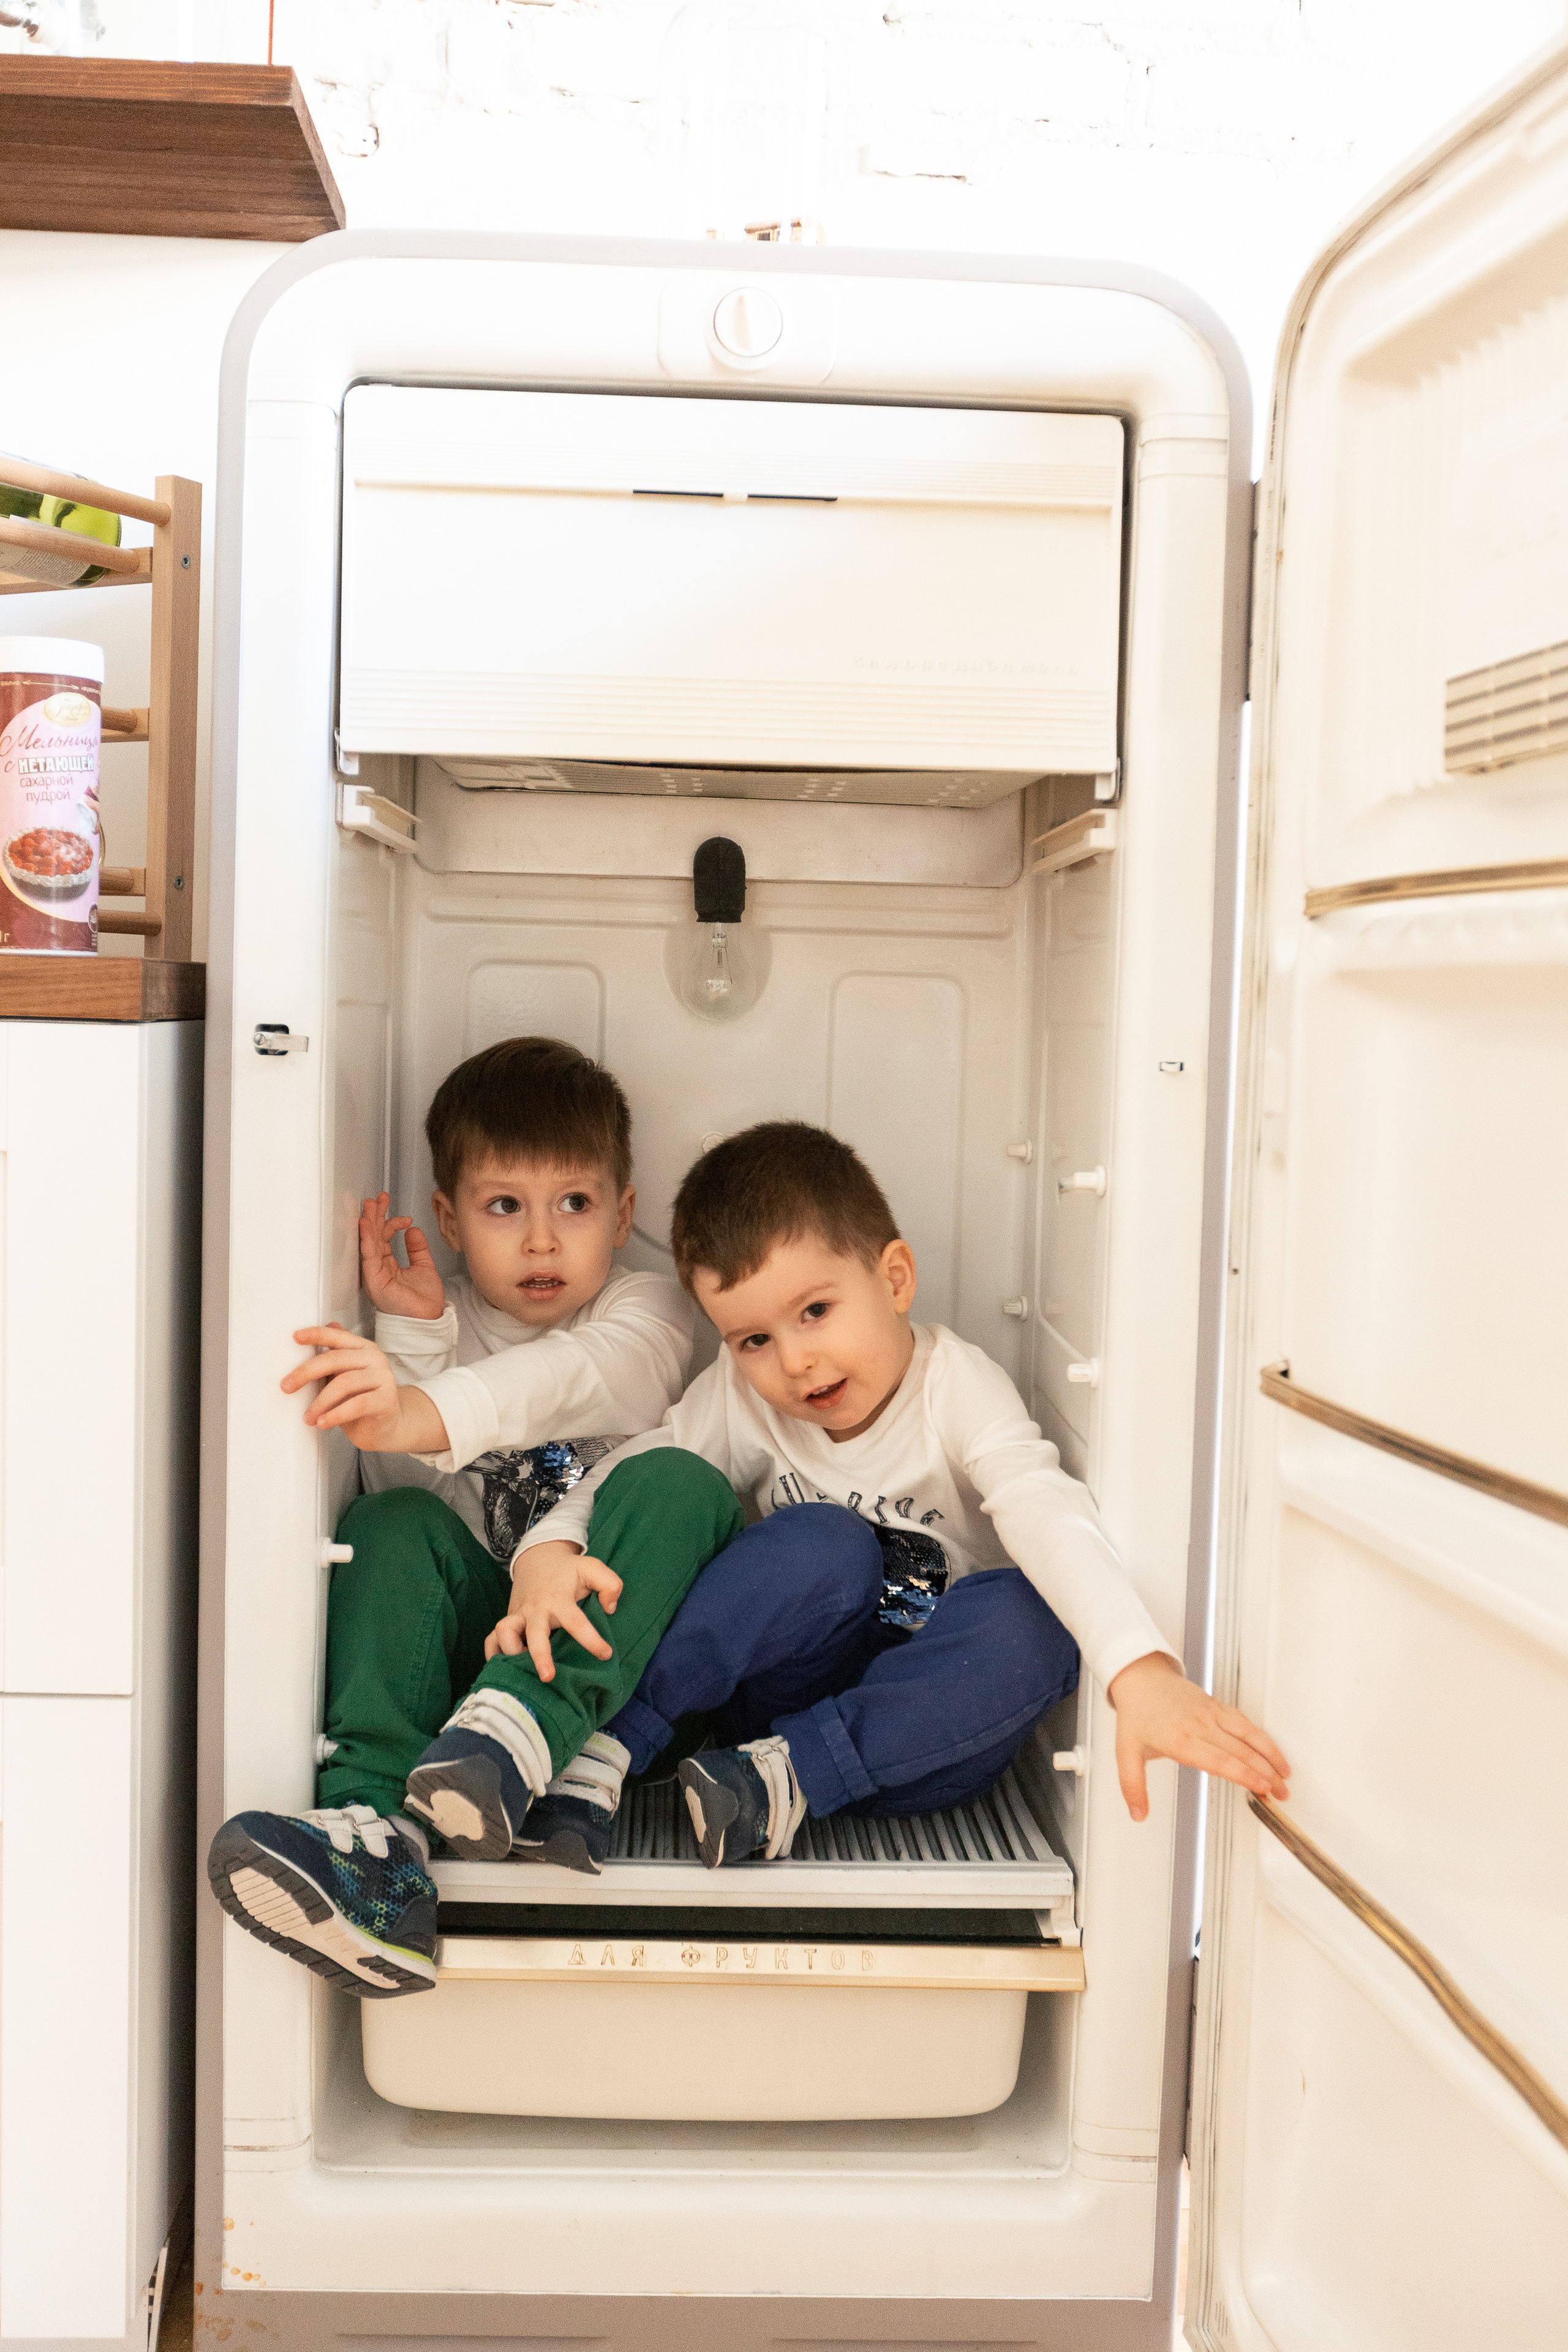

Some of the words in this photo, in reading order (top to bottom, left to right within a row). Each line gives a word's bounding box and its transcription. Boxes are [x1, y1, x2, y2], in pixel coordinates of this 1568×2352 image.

[18, 754, 94, 774] НЕТАЮЩЕЙ
[20, 775, 74, 789] сахарной
[26, 788, 70, 804] пудрой
[567, 1943, 645, 1966] ДЛЯ
[680, 1945, 874, 1971] ФРУКТОВ
